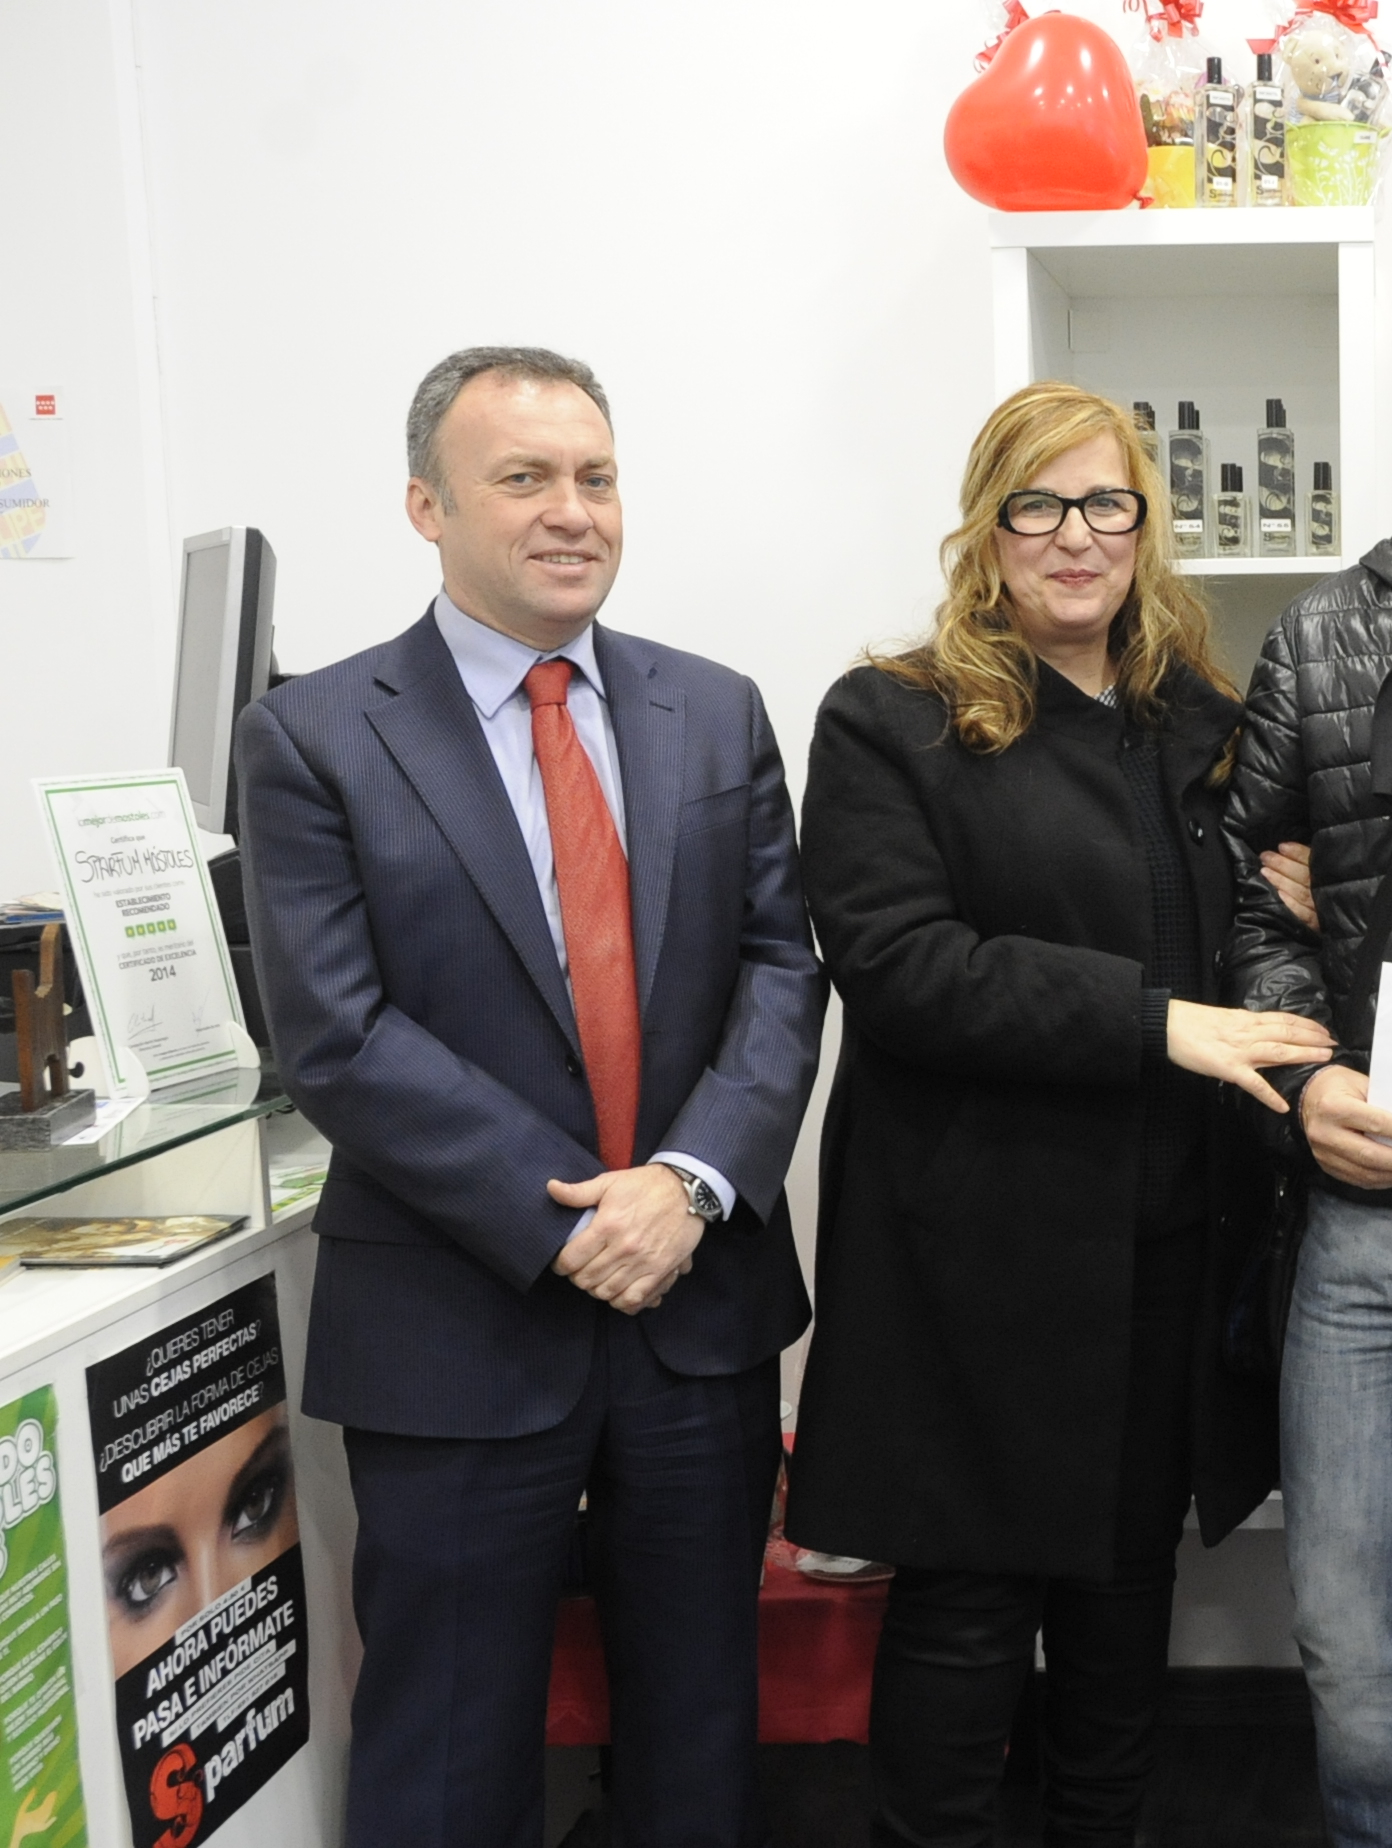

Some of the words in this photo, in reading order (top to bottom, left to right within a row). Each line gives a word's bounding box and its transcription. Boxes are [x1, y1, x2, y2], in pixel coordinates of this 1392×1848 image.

[115, 893, 171, 908] ESTABLECIMIENTO
[121, 902, 170, 917] RECOMENDADO
[118, 956, 156, 970] CERTIFICADO
[165, 949, 197, 961] EXCELENCIA
[149, 964, 176, 982] 2014
[113, 1383, 150, 1419] UNAS
[150, 1359, 192, 1398] CEJAS
[192, 1319, 263, 1374] PERFECTAS?
[146, 1327, 200, 1377] ¿QUIERES
[200, 1308, 235, 1341] TENER
[100, 1408, 175, 1473] ¿DESCUBRIR
[175, 1403, 191, 1422] LA
[191, 1377, 230, 1414] FORMA
[230, 1366, 244, 1393] DE
[246, 1346, 280, 1378] CEJAS
[120, 1455, 152, 1485] QUE
[152, 1430, 182, 1466] MÁS
[182, 1421, 199, 1446] TE
[200, 1381, 265, 1437] FAVORECE?
[132, 1691, 183, 1750] PASA
[184, 1675, 198, 1708] E
[198, 1599, 295, 1692] INFÓRMATE
[146, 1634, 208, 1699] AHORA
[210, 1575, 279, 1646] PUEDES
